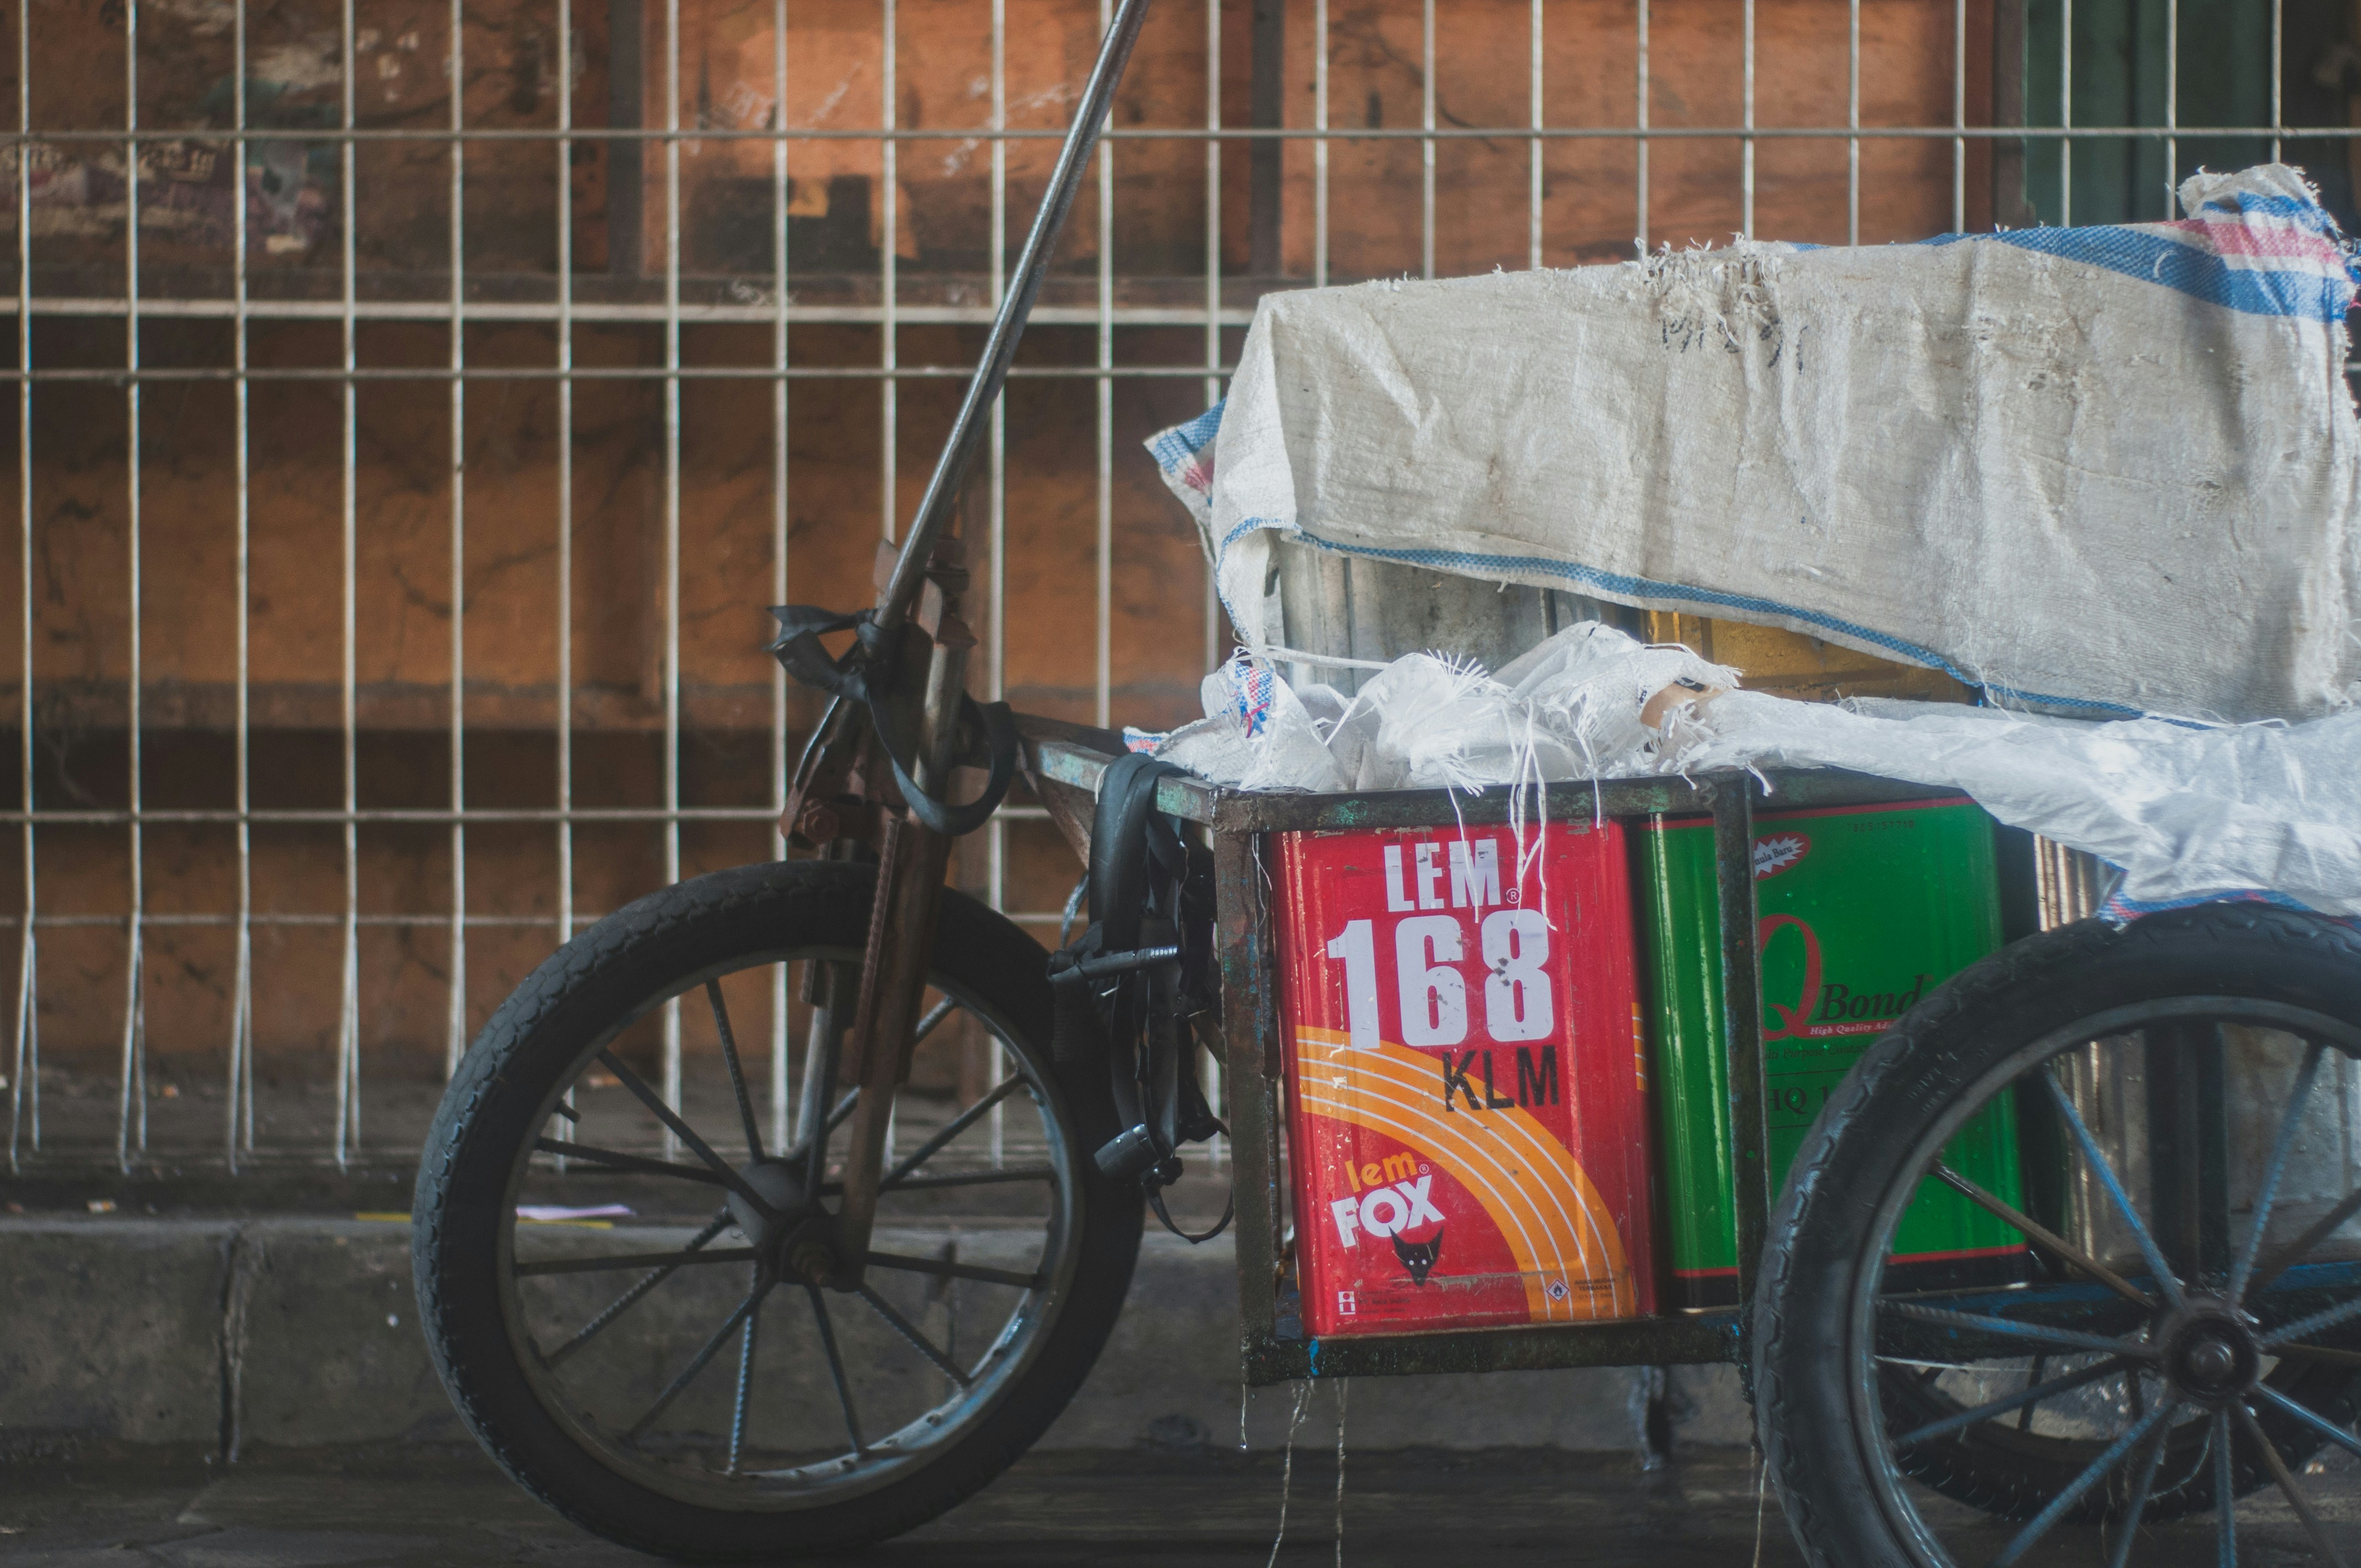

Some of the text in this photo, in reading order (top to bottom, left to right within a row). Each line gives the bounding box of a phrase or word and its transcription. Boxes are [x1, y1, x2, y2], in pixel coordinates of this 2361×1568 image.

[1384, 839, 1501, 912] LEM
[1772, 846, 1793, 858] Baru
[1327, 908, 1554, 1049] 168
[1783, 1048, 1824, 1061] Purpose
[1809, 1026, 1833, 1036] High
[1836, 1023, 1873, 1035] Quality
[1443, 1045, 1559, 1112] KLM
[1345, 1151, 1418, 1193] lem
[1330, 1174, 1446, 1248] FOX
